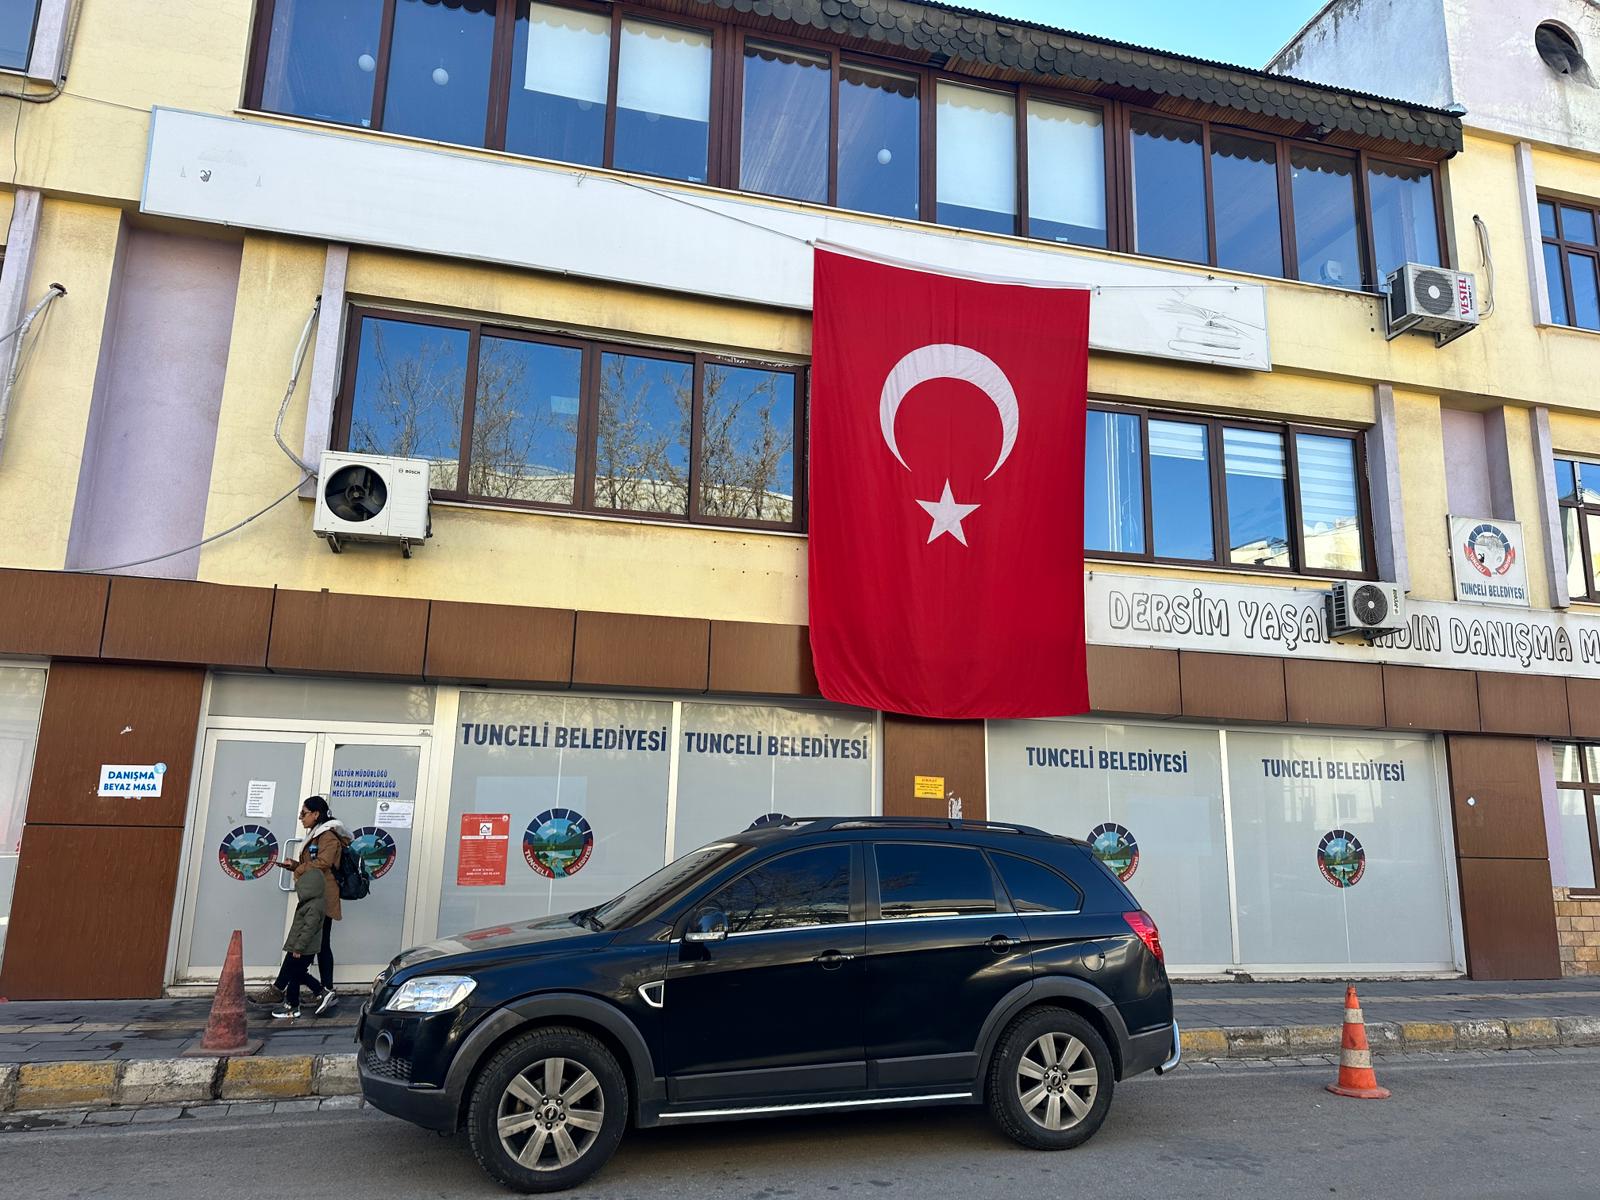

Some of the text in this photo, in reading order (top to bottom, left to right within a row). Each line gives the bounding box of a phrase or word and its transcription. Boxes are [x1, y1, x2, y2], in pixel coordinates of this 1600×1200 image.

[1459, 277, 1470, 315] VESTEL
[1460, 580, 1525, 600] TUNCELİ BELEDİYESİ
[1109, 588, 1230, 637] DERSİM
[1450, 617, 1573, 668] DANIŞMA
[461, 721, 667, 752] TUNCELİ BELEDİYESİ
[684, 730, 868, 760] TUNCELİ BELEDİYESİ
[1025, 745, 1188, 774] TUNCELİ BELEDİYESİ
[1261, 756, 1405, 782] TUNCELİ BELEDİYESİ
[103, 783, 157, 791] BEYAZ MASA
[107, 771, 155, 782] DANIŞMA
